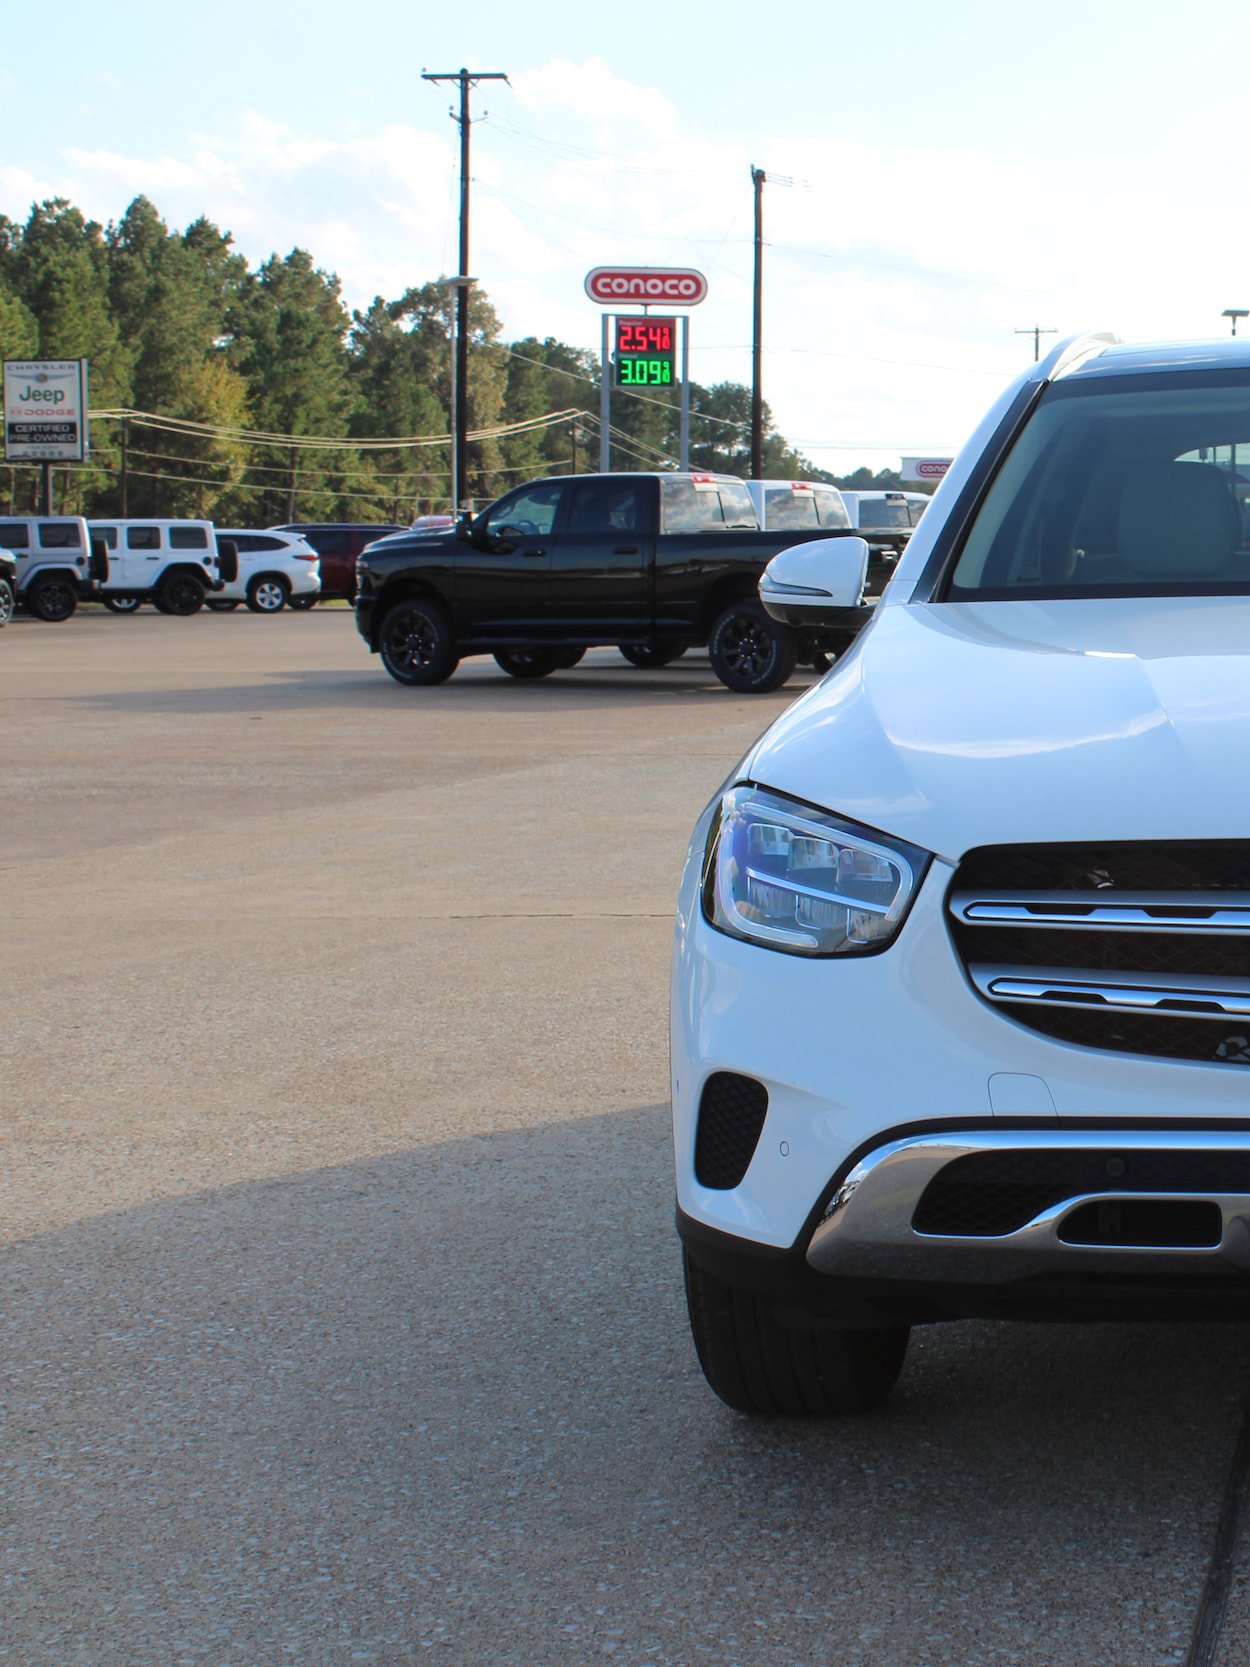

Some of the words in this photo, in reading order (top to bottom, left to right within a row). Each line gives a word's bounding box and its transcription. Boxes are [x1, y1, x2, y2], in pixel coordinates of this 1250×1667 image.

[597, 278, 697, 295] conoco
[19, 385, 65, 405] Jeep
[25, 408, 76, 416] DODGE
[15, 424, 70, 433] CERTIFIED
[10, 433, 76, 442] PRE-OWNED
